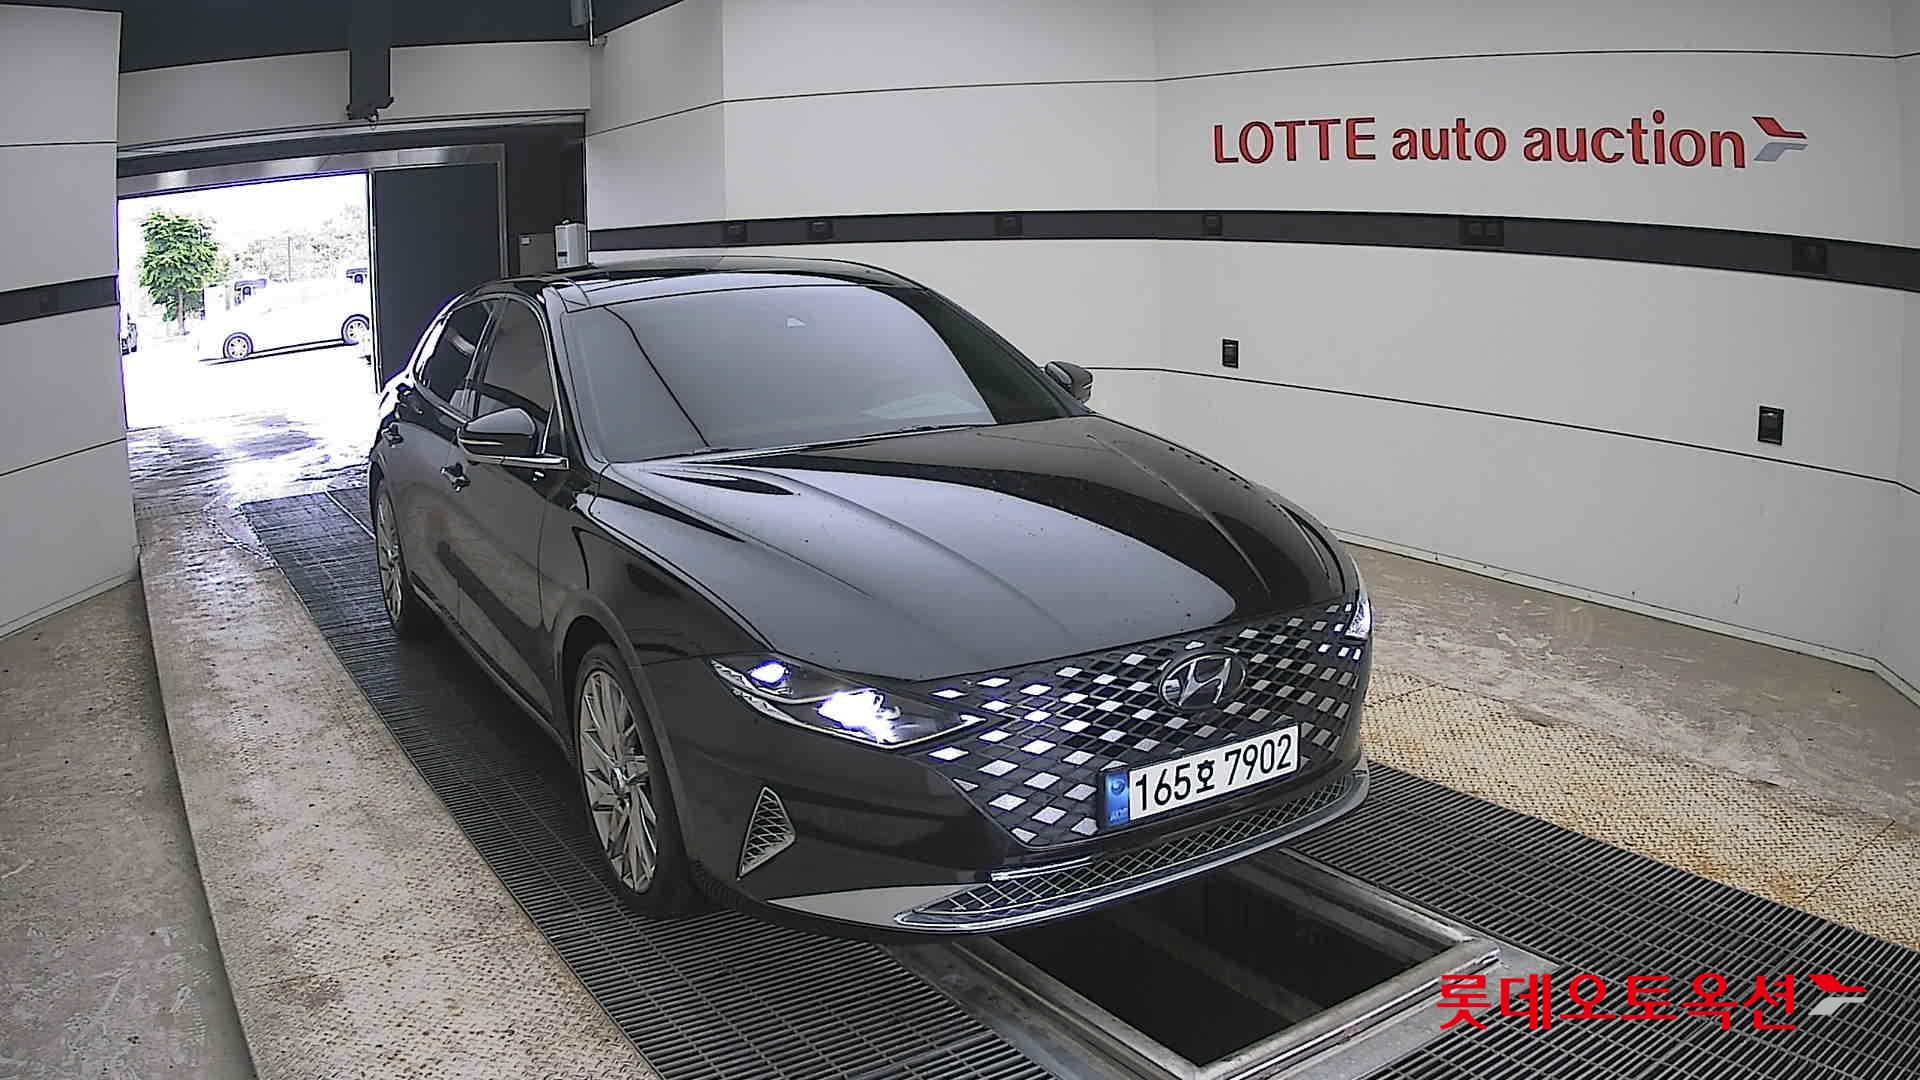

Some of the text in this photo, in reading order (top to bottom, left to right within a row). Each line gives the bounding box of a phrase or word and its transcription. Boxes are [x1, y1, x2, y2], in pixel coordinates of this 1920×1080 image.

[1213, 110, 1746, 169] LOTTE auto auction
[1135, 733, 1292, 812] 165호 7902
